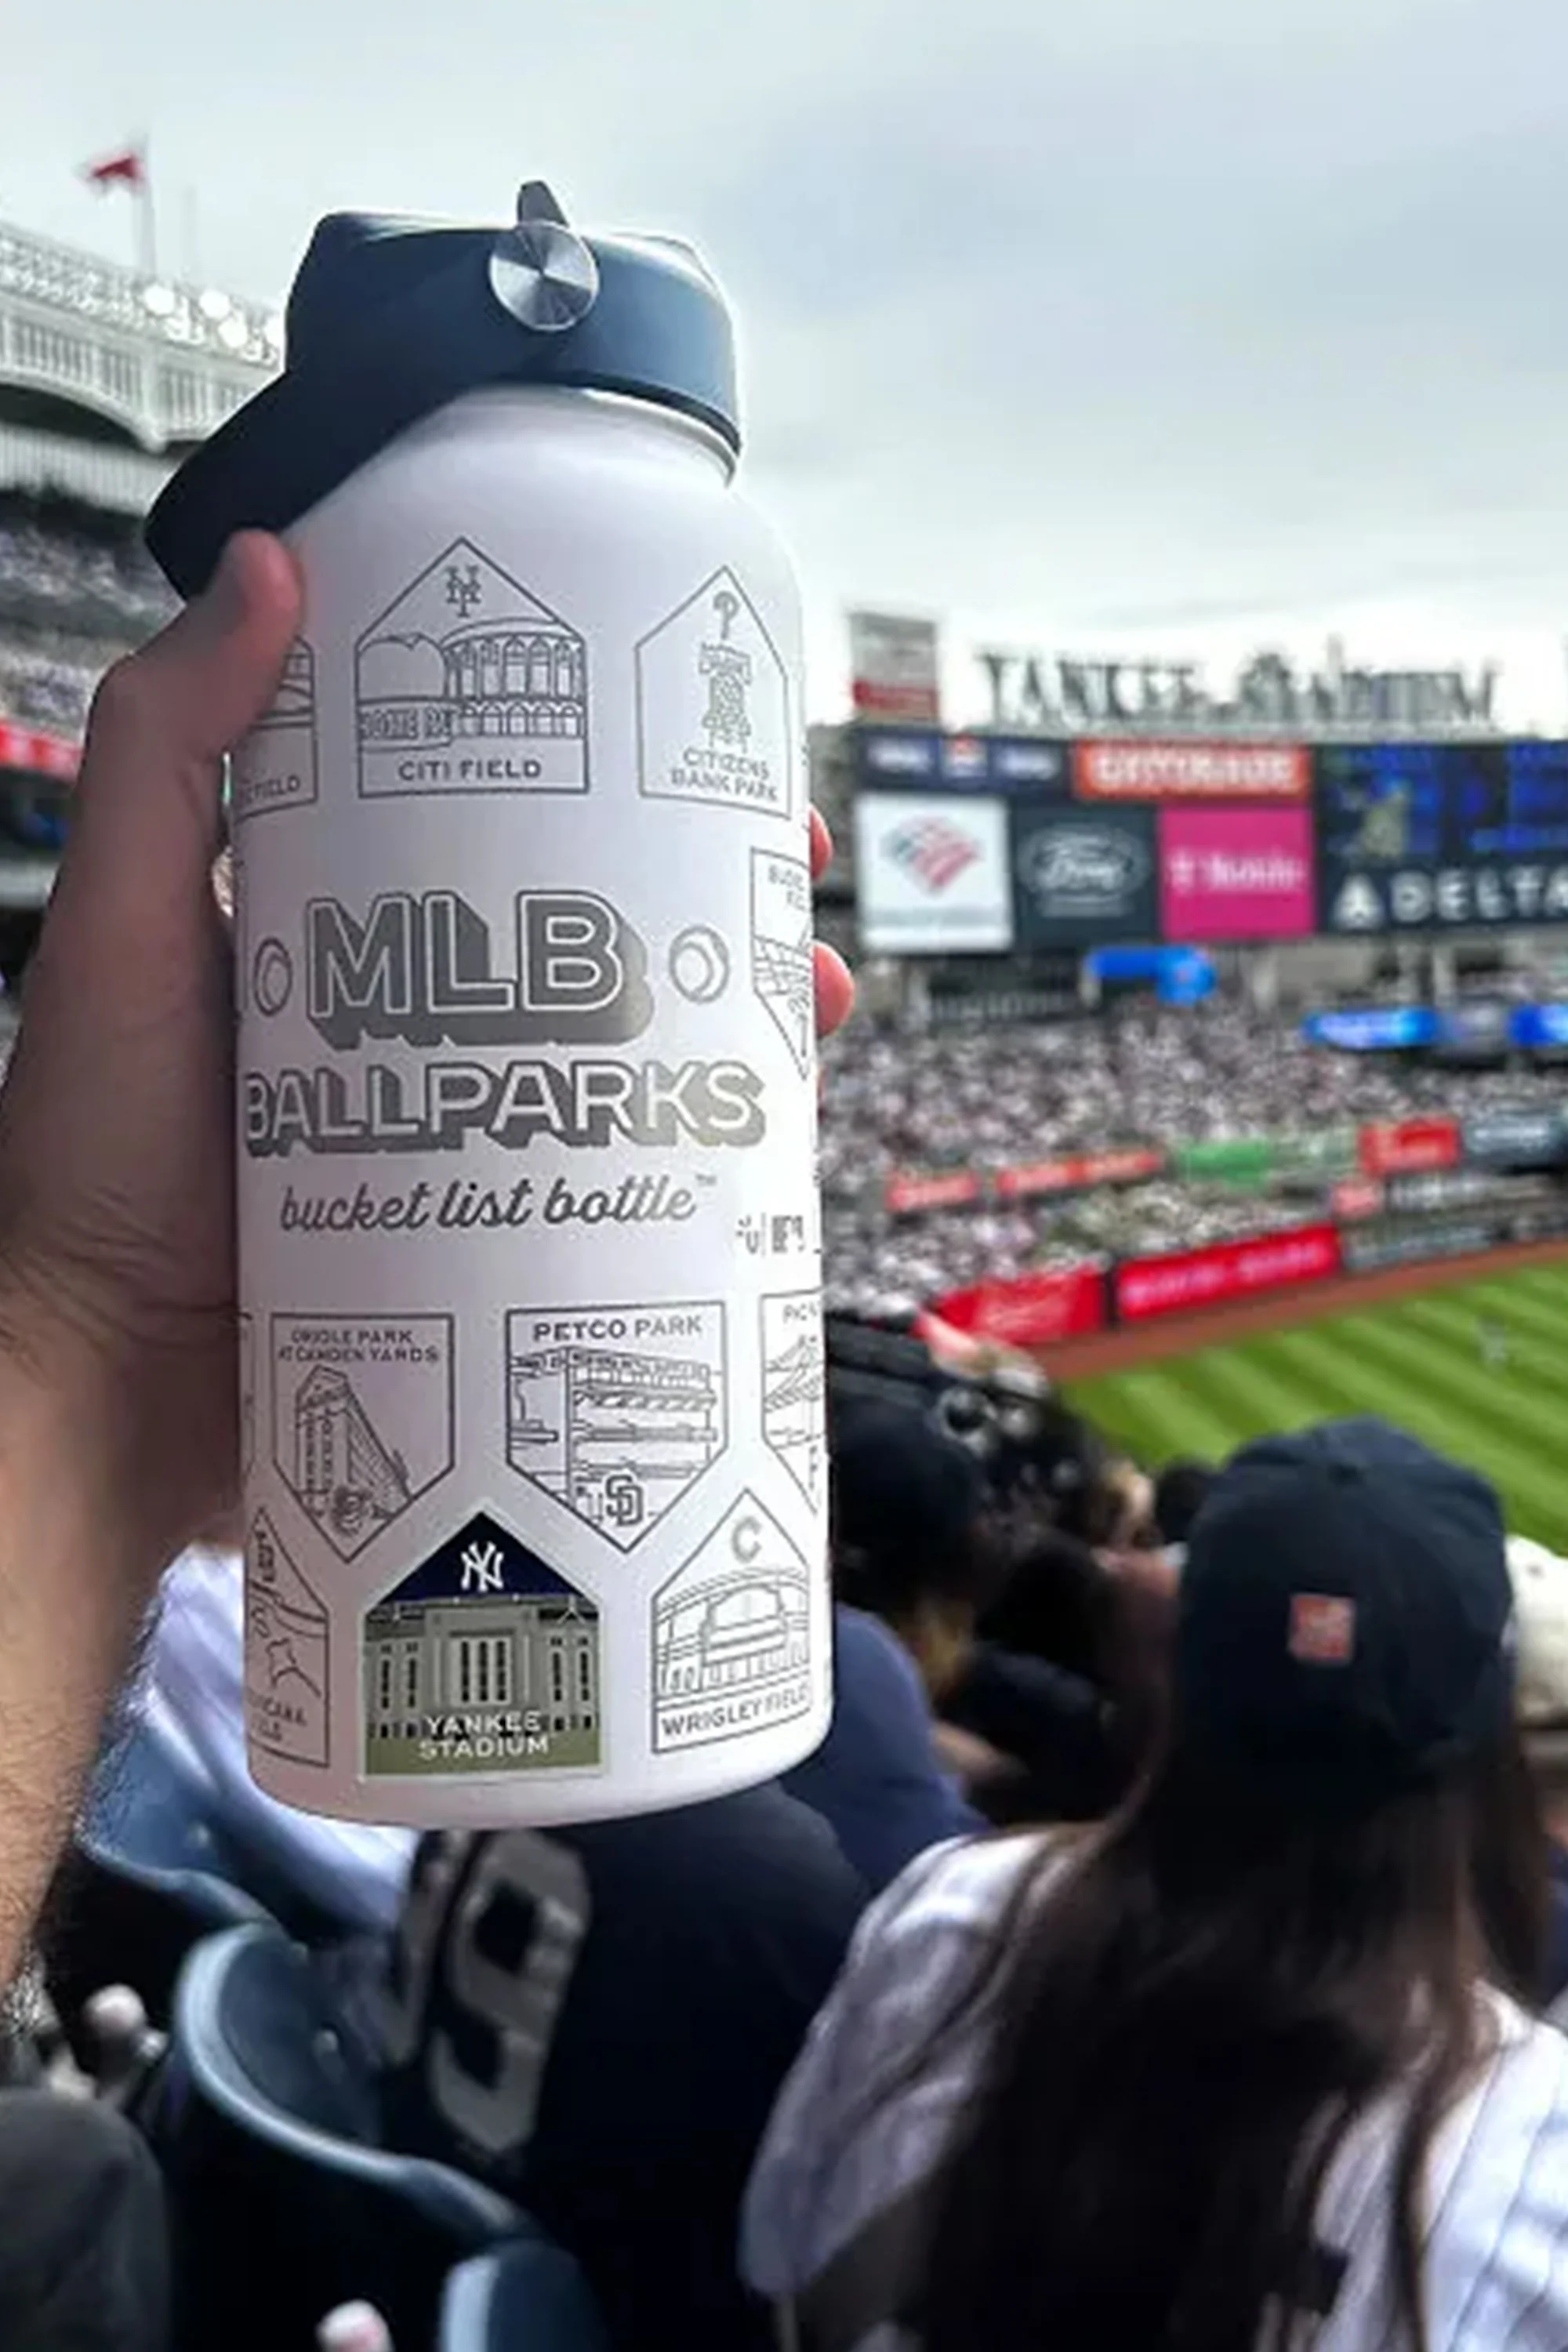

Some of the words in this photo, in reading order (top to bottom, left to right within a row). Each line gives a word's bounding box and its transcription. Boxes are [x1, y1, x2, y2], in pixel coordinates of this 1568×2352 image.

[397, 760, 451, 782] CITI
[459, 758, 542, 779] FIELD
[671, 768, 731, 794] BANK
[306, 890, 655, 1051] MLB
[245, 1061, 766, 1158] BALLPARKS
[280, 1185, 427, 1232] bucket
[437, 1179, 534, 1228] list
[358, 1330, 413, 1344] PARK
[533, 1319, 626, 1342] PETCO
[633, 1315, 703, 1338] PARK
[368, 1346, 439, 1363] YARDS
[731, 1515, 762, 1564] C
[459, 1541, 505, 1592] NY
[424, 1710, 542, 1736] YANKEE
[661, 1697, 762, 1736] WRIGLEY
[419, 1734, 549, 1761] STADIUM
